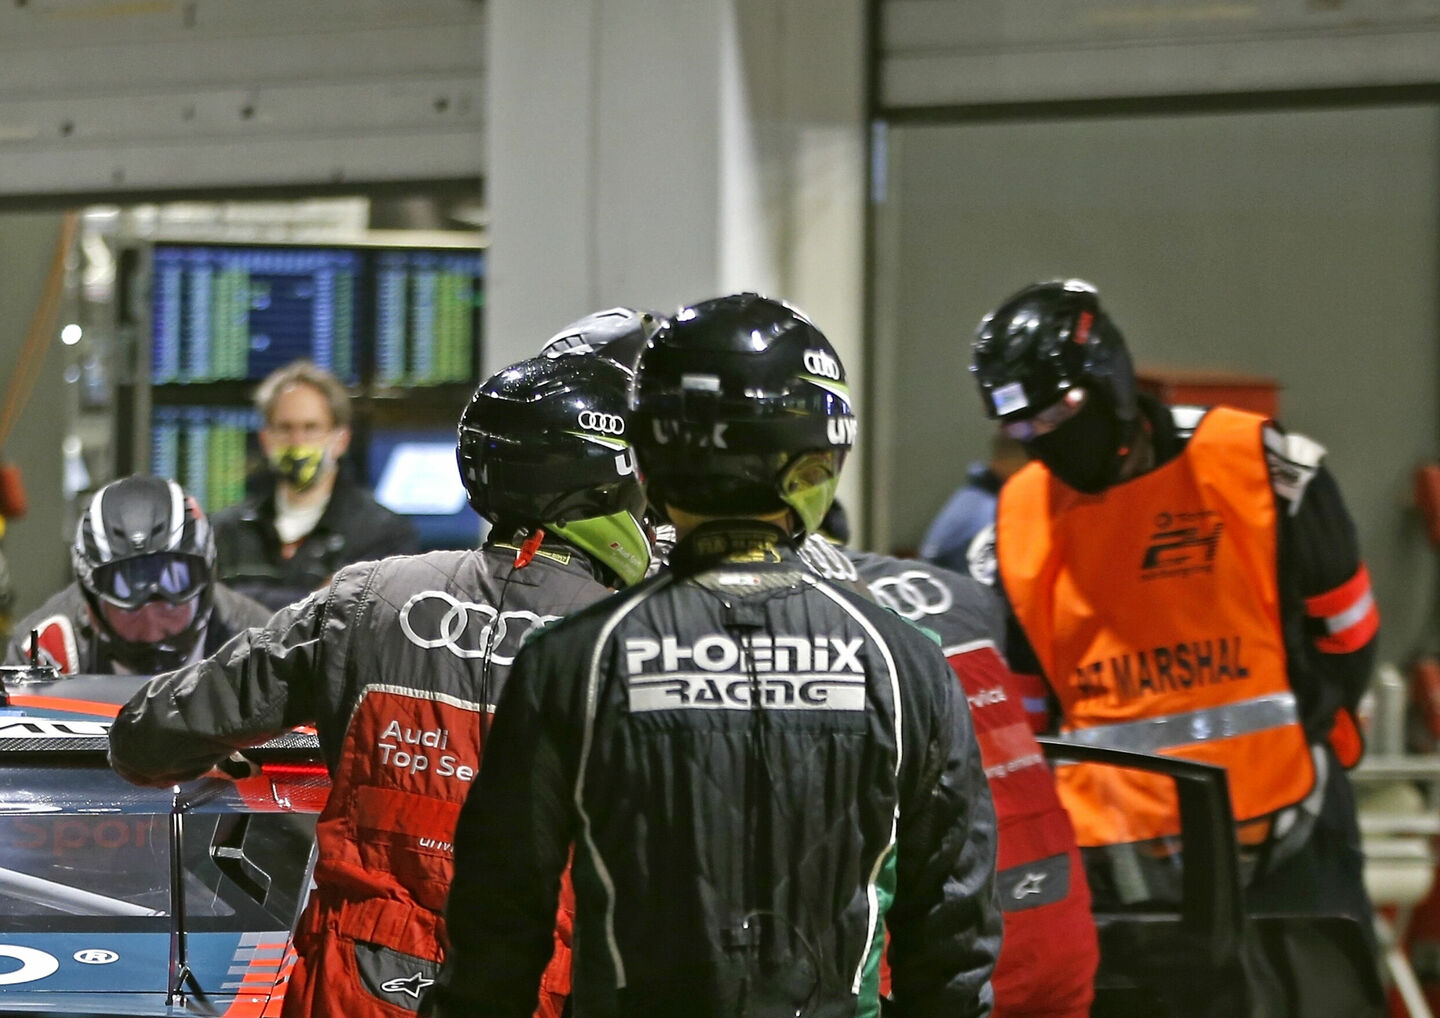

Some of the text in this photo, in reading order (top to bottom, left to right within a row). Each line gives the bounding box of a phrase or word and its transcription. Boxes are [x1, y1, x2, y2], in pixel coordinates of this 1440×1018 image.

[380, 720, 449, 750] Audi
[378, 743, 474, 782] Top Se
[14, 815, 158, 857] Spor
